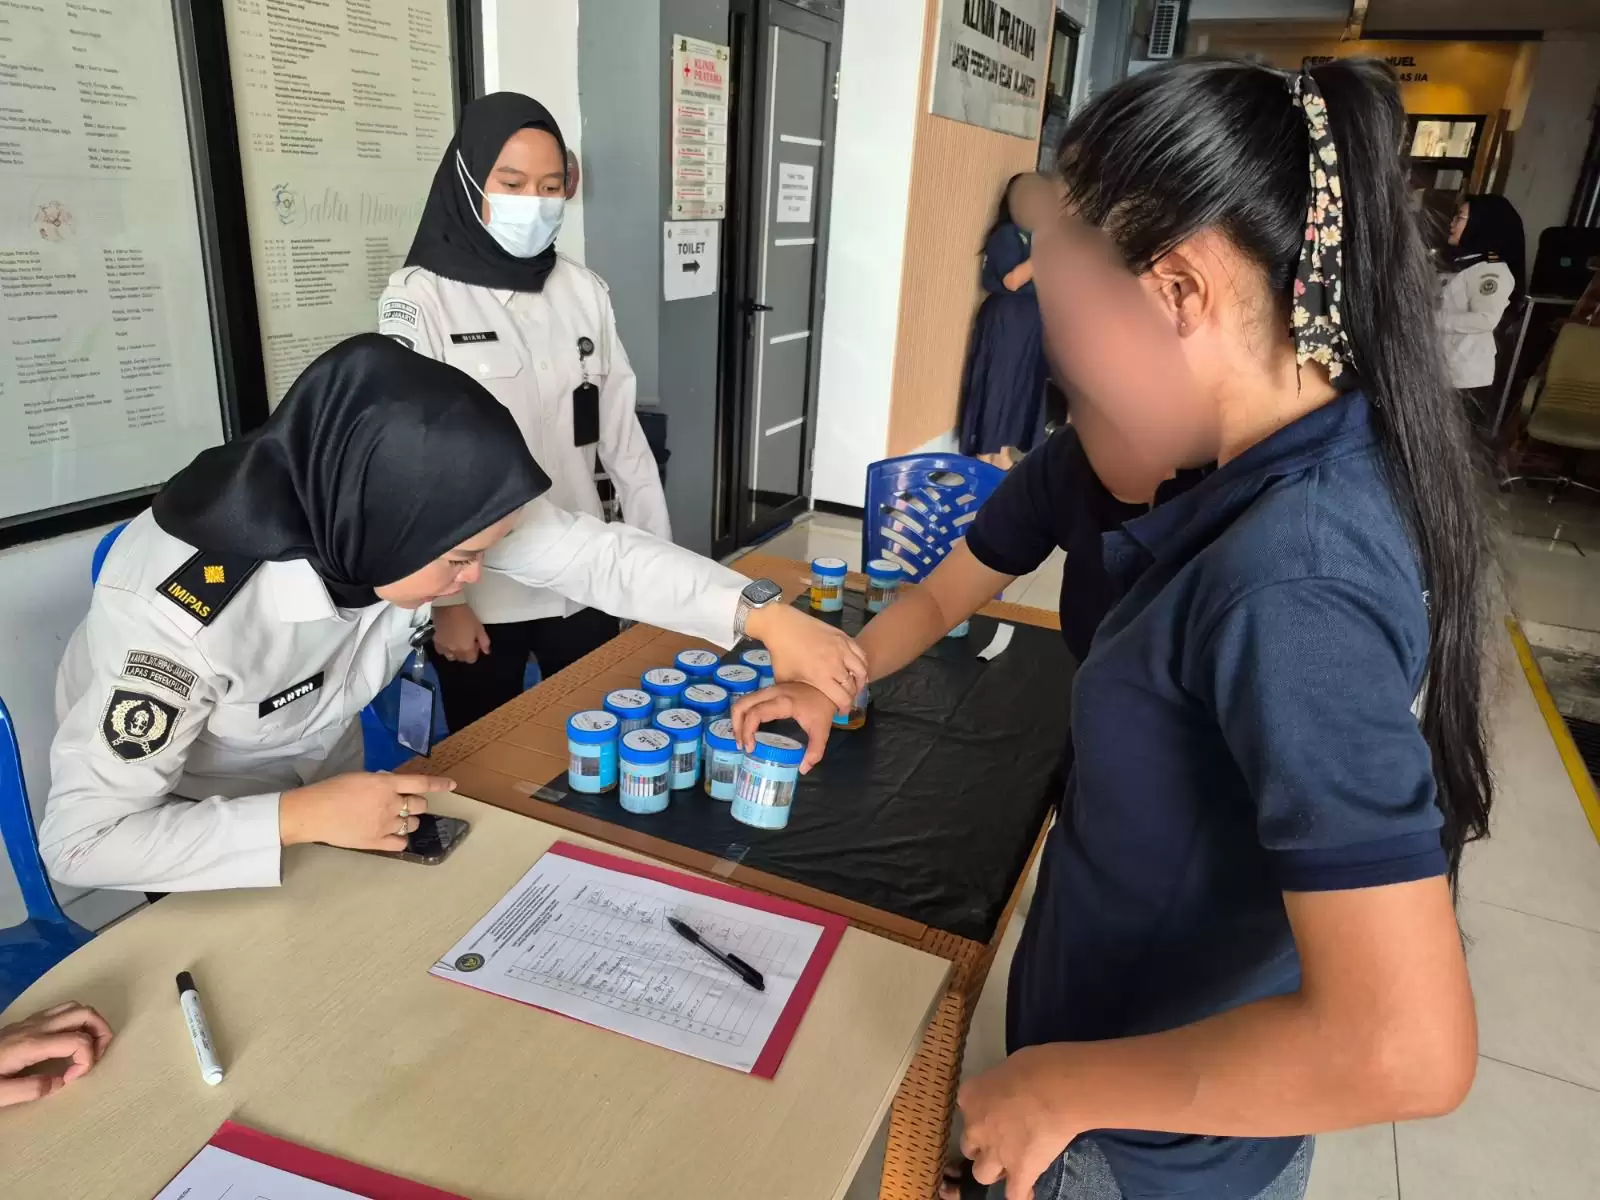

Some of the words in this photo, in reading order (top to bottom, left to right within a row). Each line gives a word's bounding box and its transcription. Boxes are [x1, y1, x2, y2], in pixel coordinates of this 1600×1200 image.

[997, 6, 1037, 61] PRATAMA
[677, 242, 705, 255] TOILET
[167, 582, 211, 617] IMIPAS
[126, 666, 149, 678] LAPAS
[149, 671, 188, 696] PEREMPUAN
[272, 681, 314, 709] TANTRI
